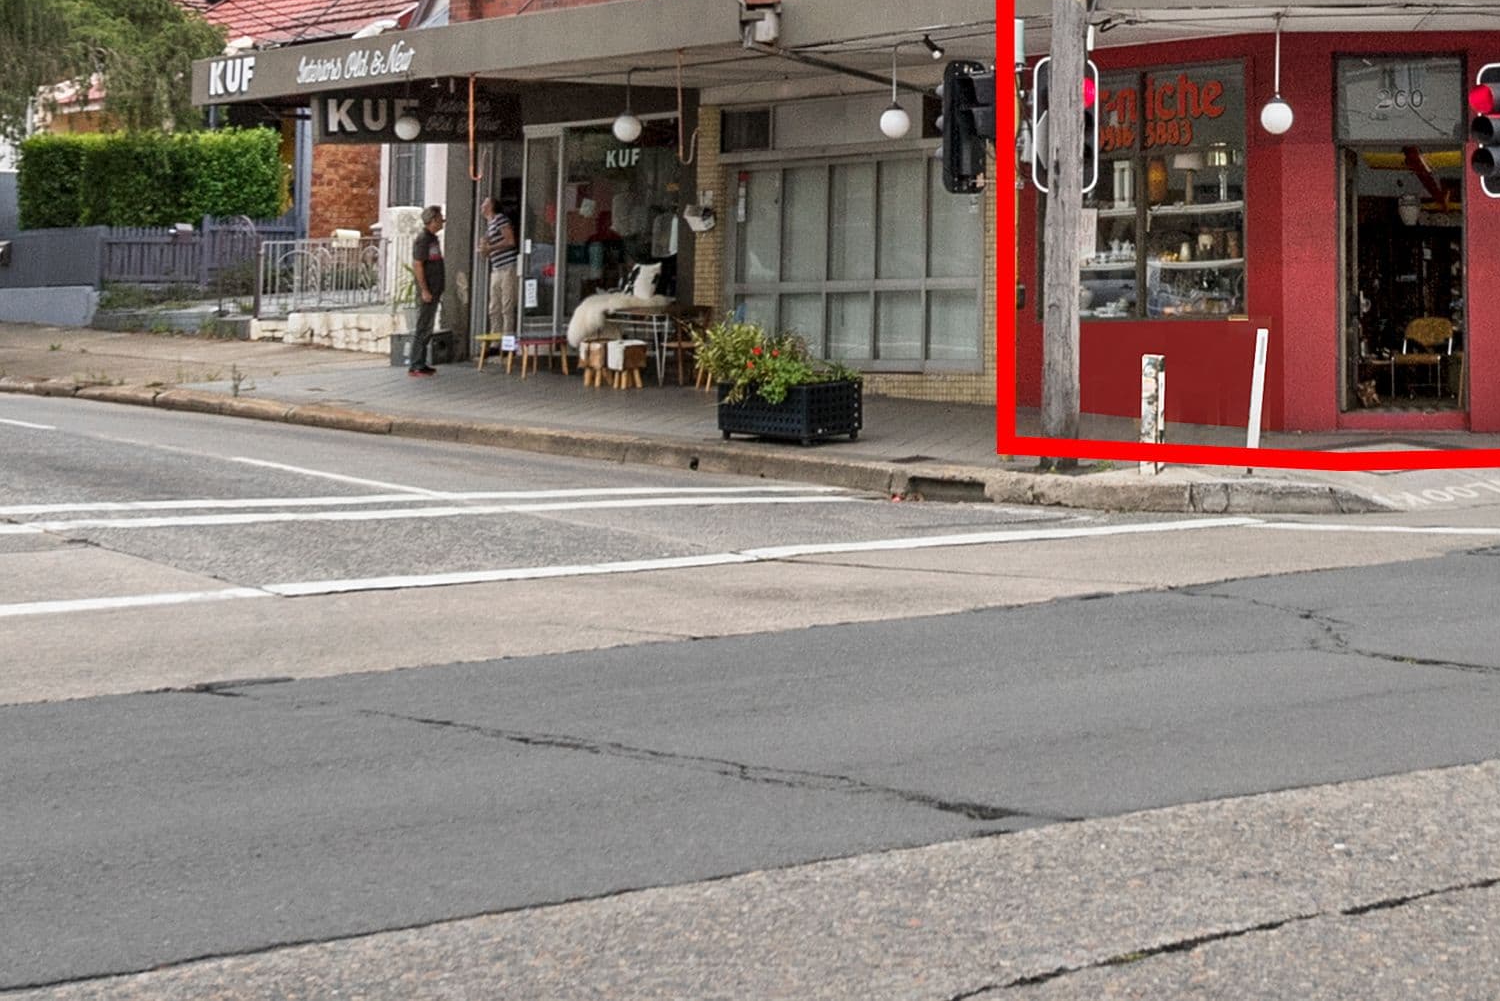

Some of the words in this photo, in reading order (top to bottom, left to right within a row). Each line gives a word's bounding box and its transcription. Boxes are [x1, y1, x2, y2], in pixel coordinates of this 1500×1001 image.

[208, 56, 256, 96] KUF
[344, 50, 369, 79] Old
[382, 40, 416, 74] New
[327, 98, 420, 132] KUF
[605, 148, 641, 168] KUF
